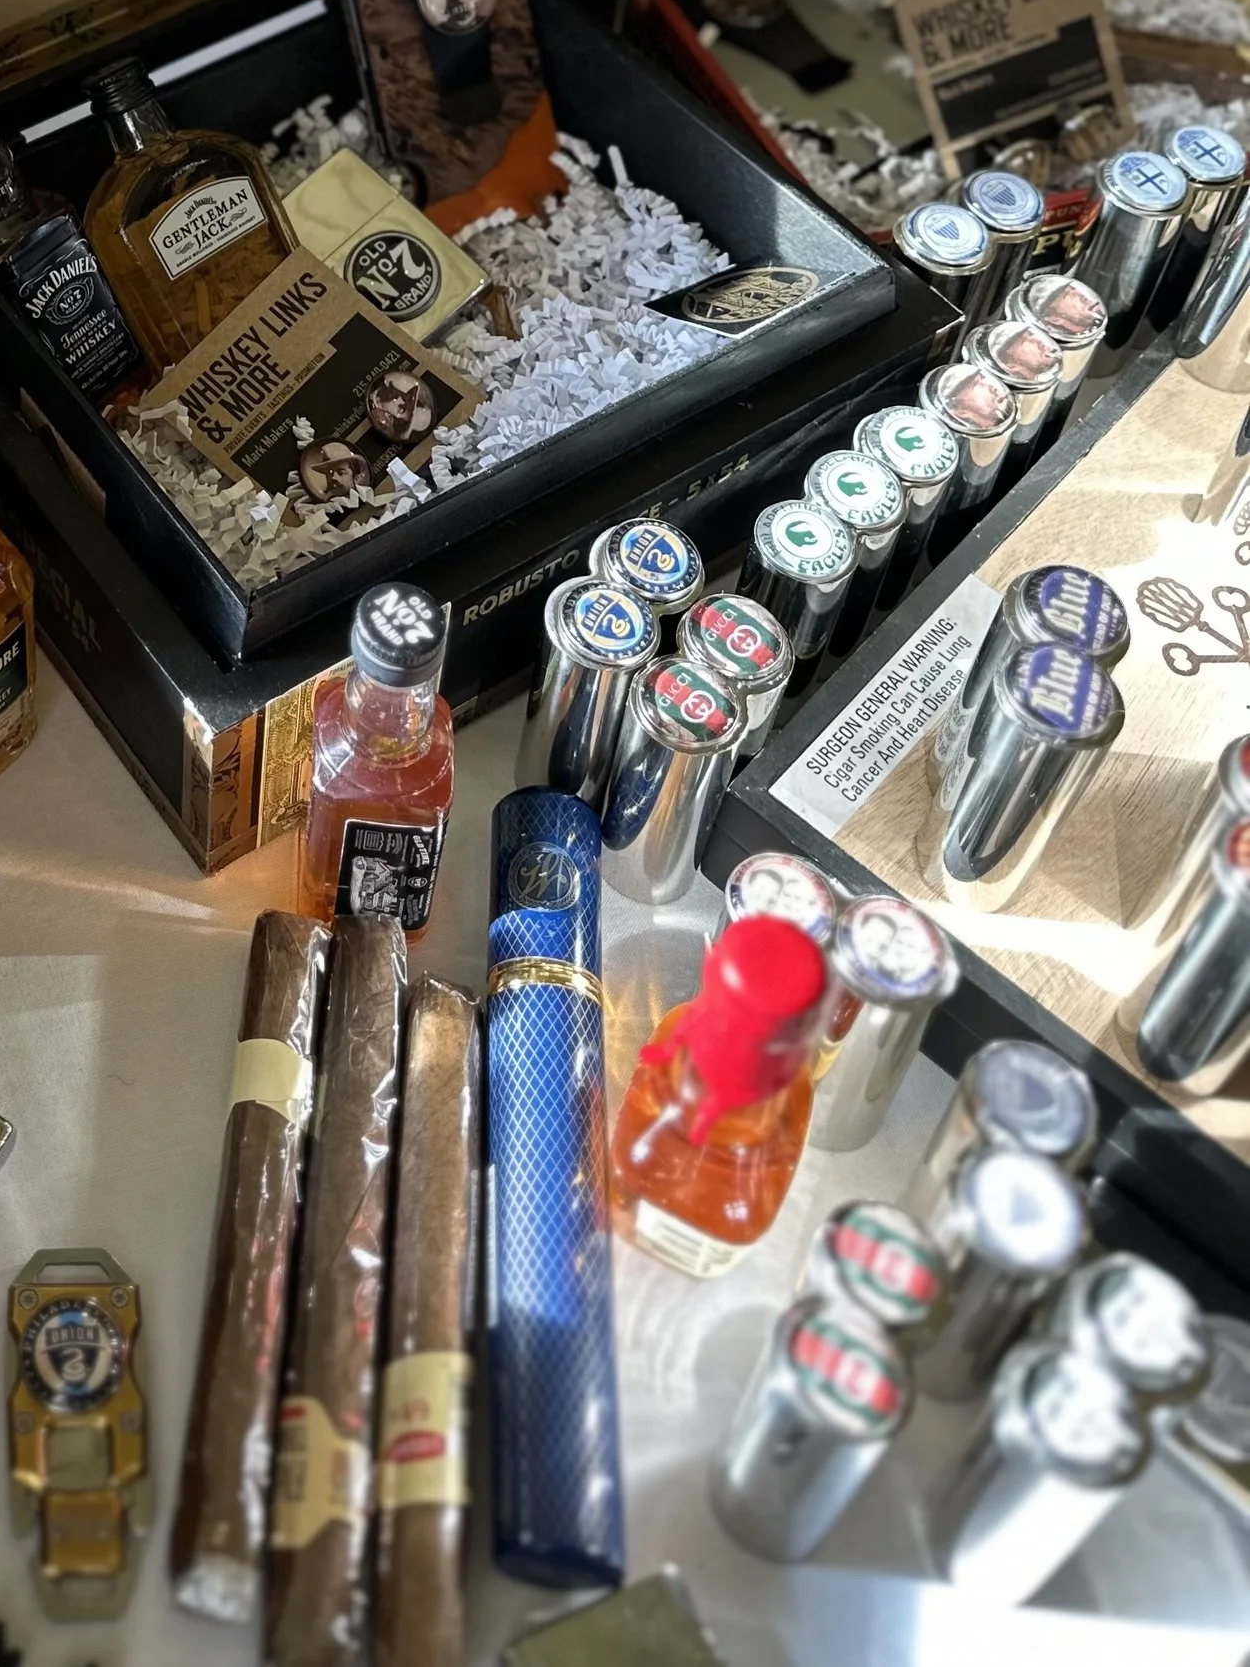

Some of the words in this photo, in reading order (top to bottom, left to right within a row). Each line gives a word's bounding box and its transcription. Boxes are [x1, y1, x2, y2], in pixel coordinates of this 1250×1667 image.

[162, 188, 250, 250] GENTLEMAN
[193, 216, 230, 249] JACK
[358, 240, 387, 267] OLD
[25, 280, 56, 319] JACK
[49, 253, 99, 289] DANIEL'S
[394, 273, 433, 310] BRAND
[60, 309, 108, 350] Tennessee
[65, 319, 118, 366] WHISKEY
[178, 325, 270, 424] WHISKEY
[259, 271, 328, 338] LINKS
[196, 414, 233, 445] &
[218, 352, 292, 423] MORE
[223, 430, 247, 455] PRIVATE
[246, 409, 267, 433] EVENTS
[266, 383, 296, 411] TASTINGS
[240, 443, 264, 469] Mark
[260, 416, 295, 448] Makers
[847, 479, 899, 526] EAGLES
[629, 532, 655, 562] UNION
[797, 527, 849, 575] EAGLES
[408, 596, 433, 620] OLD
[463, 549, 581, 627] ROBUSTO
[584, 595, 610, 627] UNION
[1043, 570, 1092, 640] Blue
[705, 608, 738, 642] GUCCI
[658, 672, 692, 708] GUCCI
[806, 716, 864, 775] SURGEON
[855, 670, 909, 723] GENERAL
[898, 617, 958, 674] WARNING:
[1030, 647, 1083, 722] Blue
[823, 755, 858, 790] Cigar
[852, 712, 901, 761] Smoking
[893, 690, 919, 717] Can
[910, 659, 947, 695] Cause
[943, 633, 973, 664] Lung
[841, 760, 885, 803] Cancer
[877, 735, 905, 766] And
[901, 706, 934, 743] Heart
[51, 1326, 95, 1343] UNION
